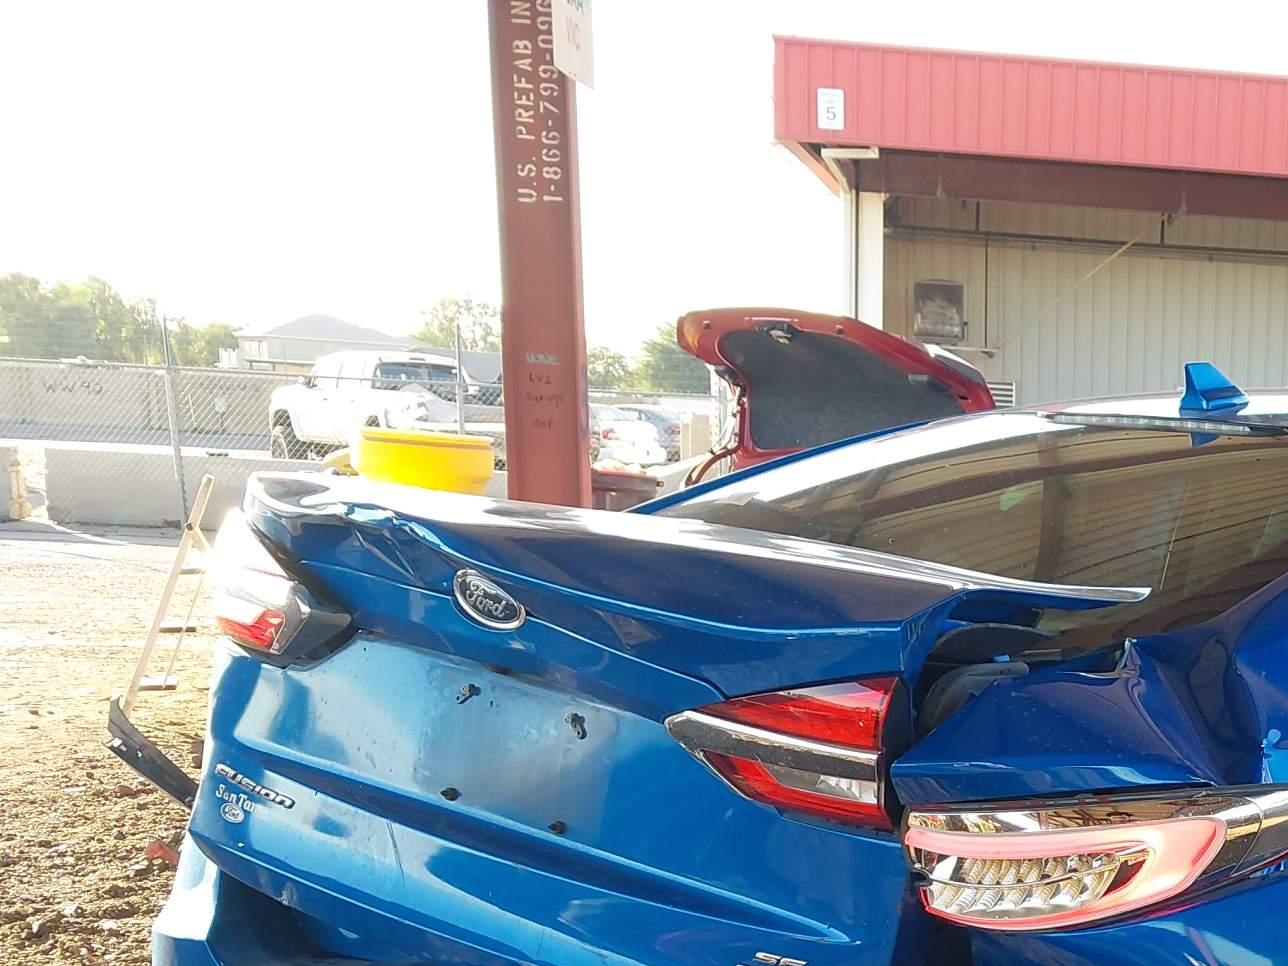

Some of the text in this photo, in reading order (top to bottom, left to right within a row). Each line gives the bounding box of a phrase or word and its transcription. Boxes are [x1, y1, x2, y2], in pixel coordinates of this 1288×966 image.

[512, 39, 536, 140] PREFAB
[826, 106, 836, 121] 5
[517, 155, 537, 203] U.S.
[465, 579, 510, 618] Ford
[215, 784, 238, 804] San
